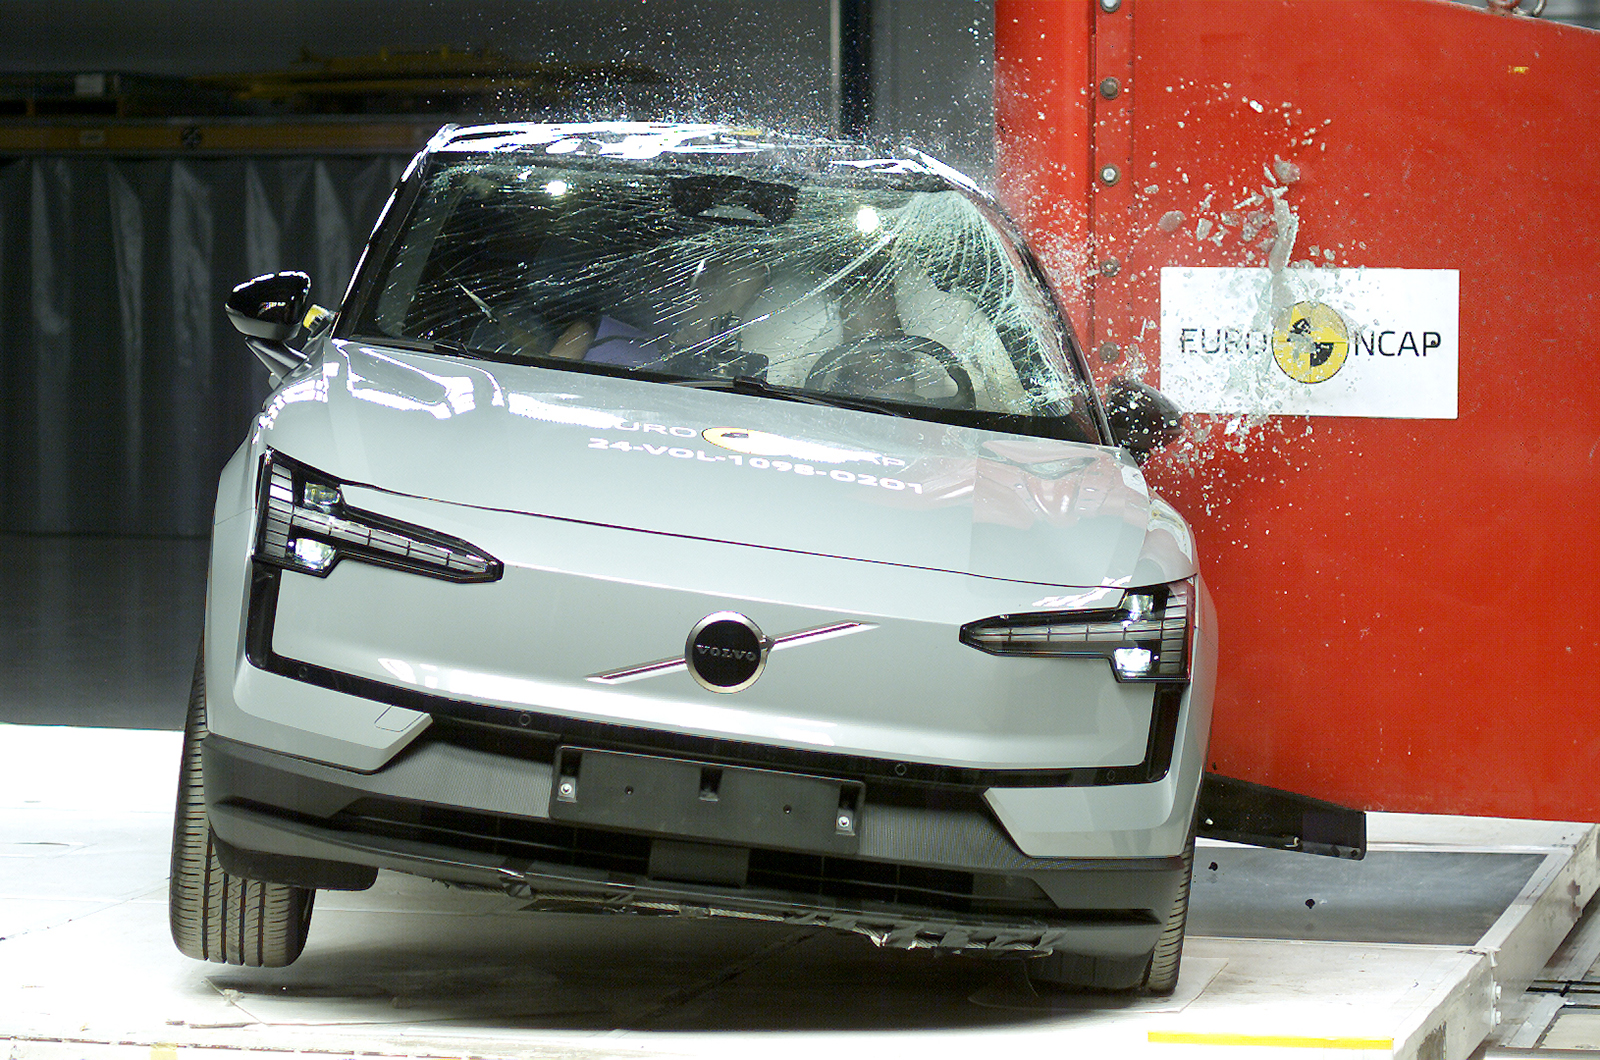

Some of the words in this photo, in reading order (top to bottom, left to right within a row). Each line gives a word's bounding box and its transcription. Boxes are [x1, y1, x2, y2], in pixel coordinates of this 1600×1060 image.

[1180, 327, 1268, 355] EURO
[1354, 330, 1442, 357] NCAP
[588, 437, 923, 495] 24-VOL-1098-0201
[696, 644, 757, 662] VOLVO
